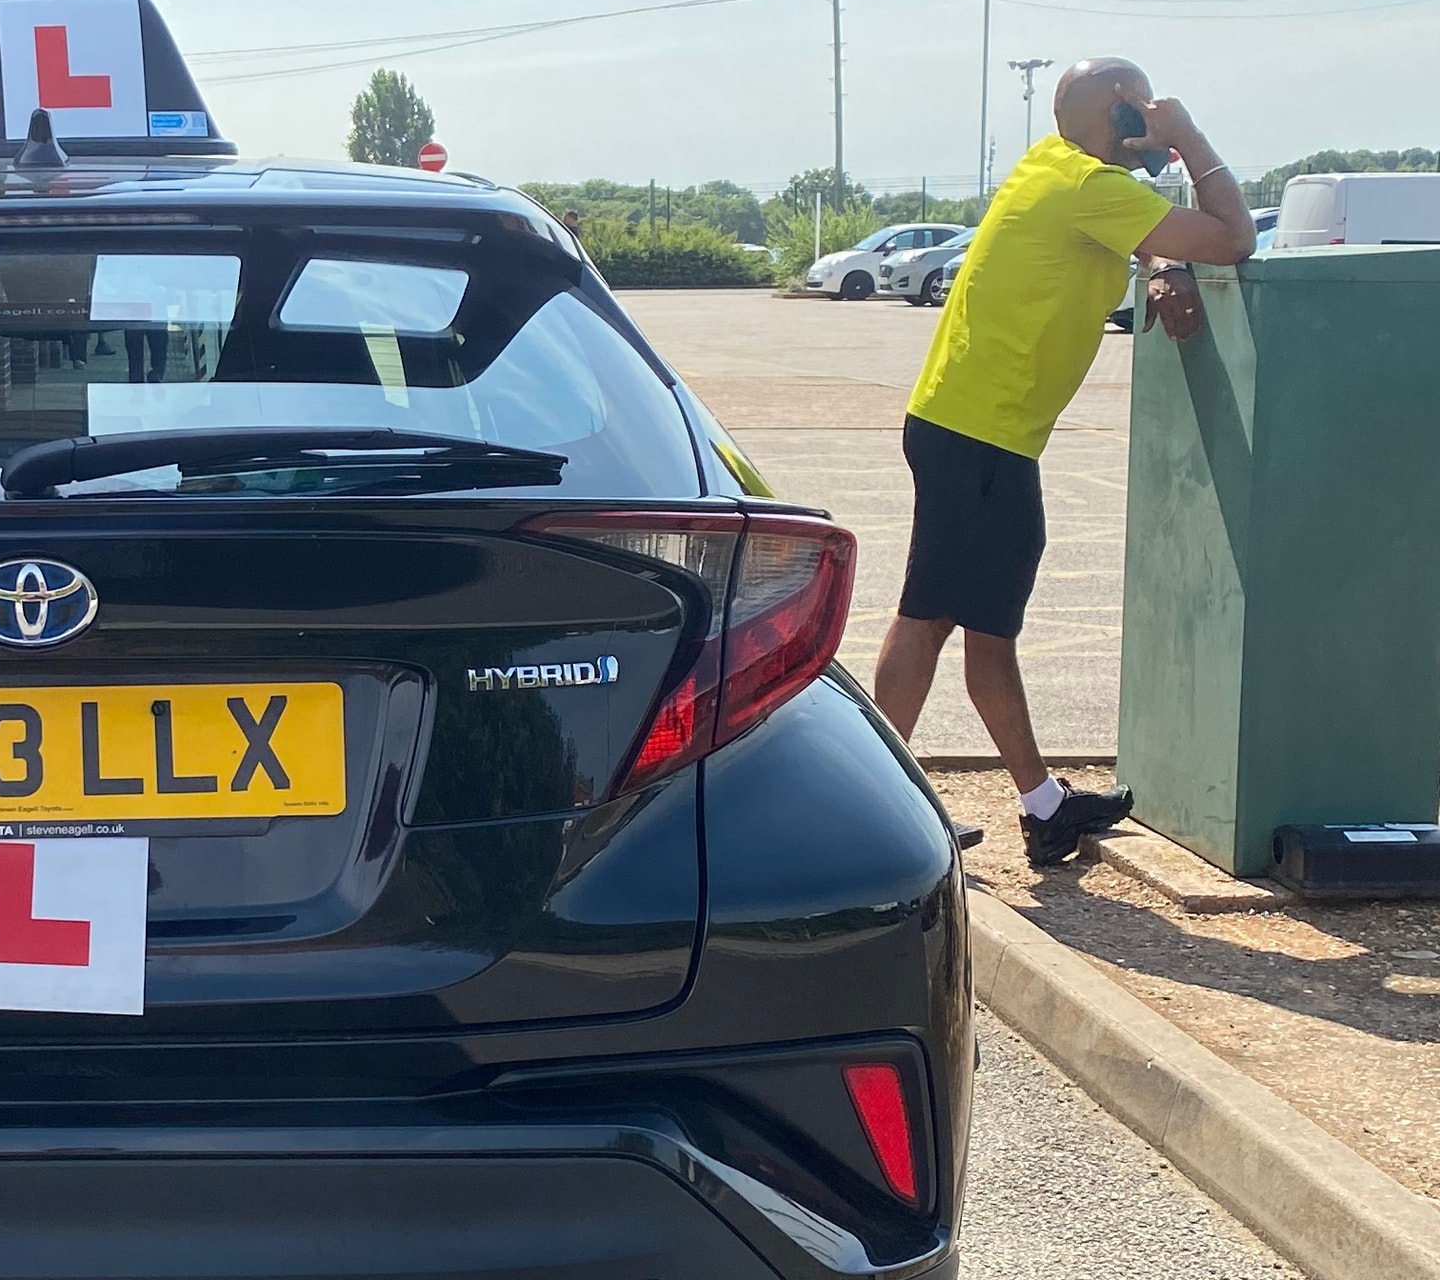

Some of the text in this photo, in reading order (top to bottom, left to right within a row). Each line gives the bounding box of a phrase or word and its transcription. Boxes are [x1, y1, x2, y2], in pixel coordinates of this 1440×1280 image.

[34, 25, 112, 109] L
[467, 662, 596, 692] HYBRID
[81, 695, 291, 796] LLX
[26, 823, 125, 837] steveneagell.co.uk
